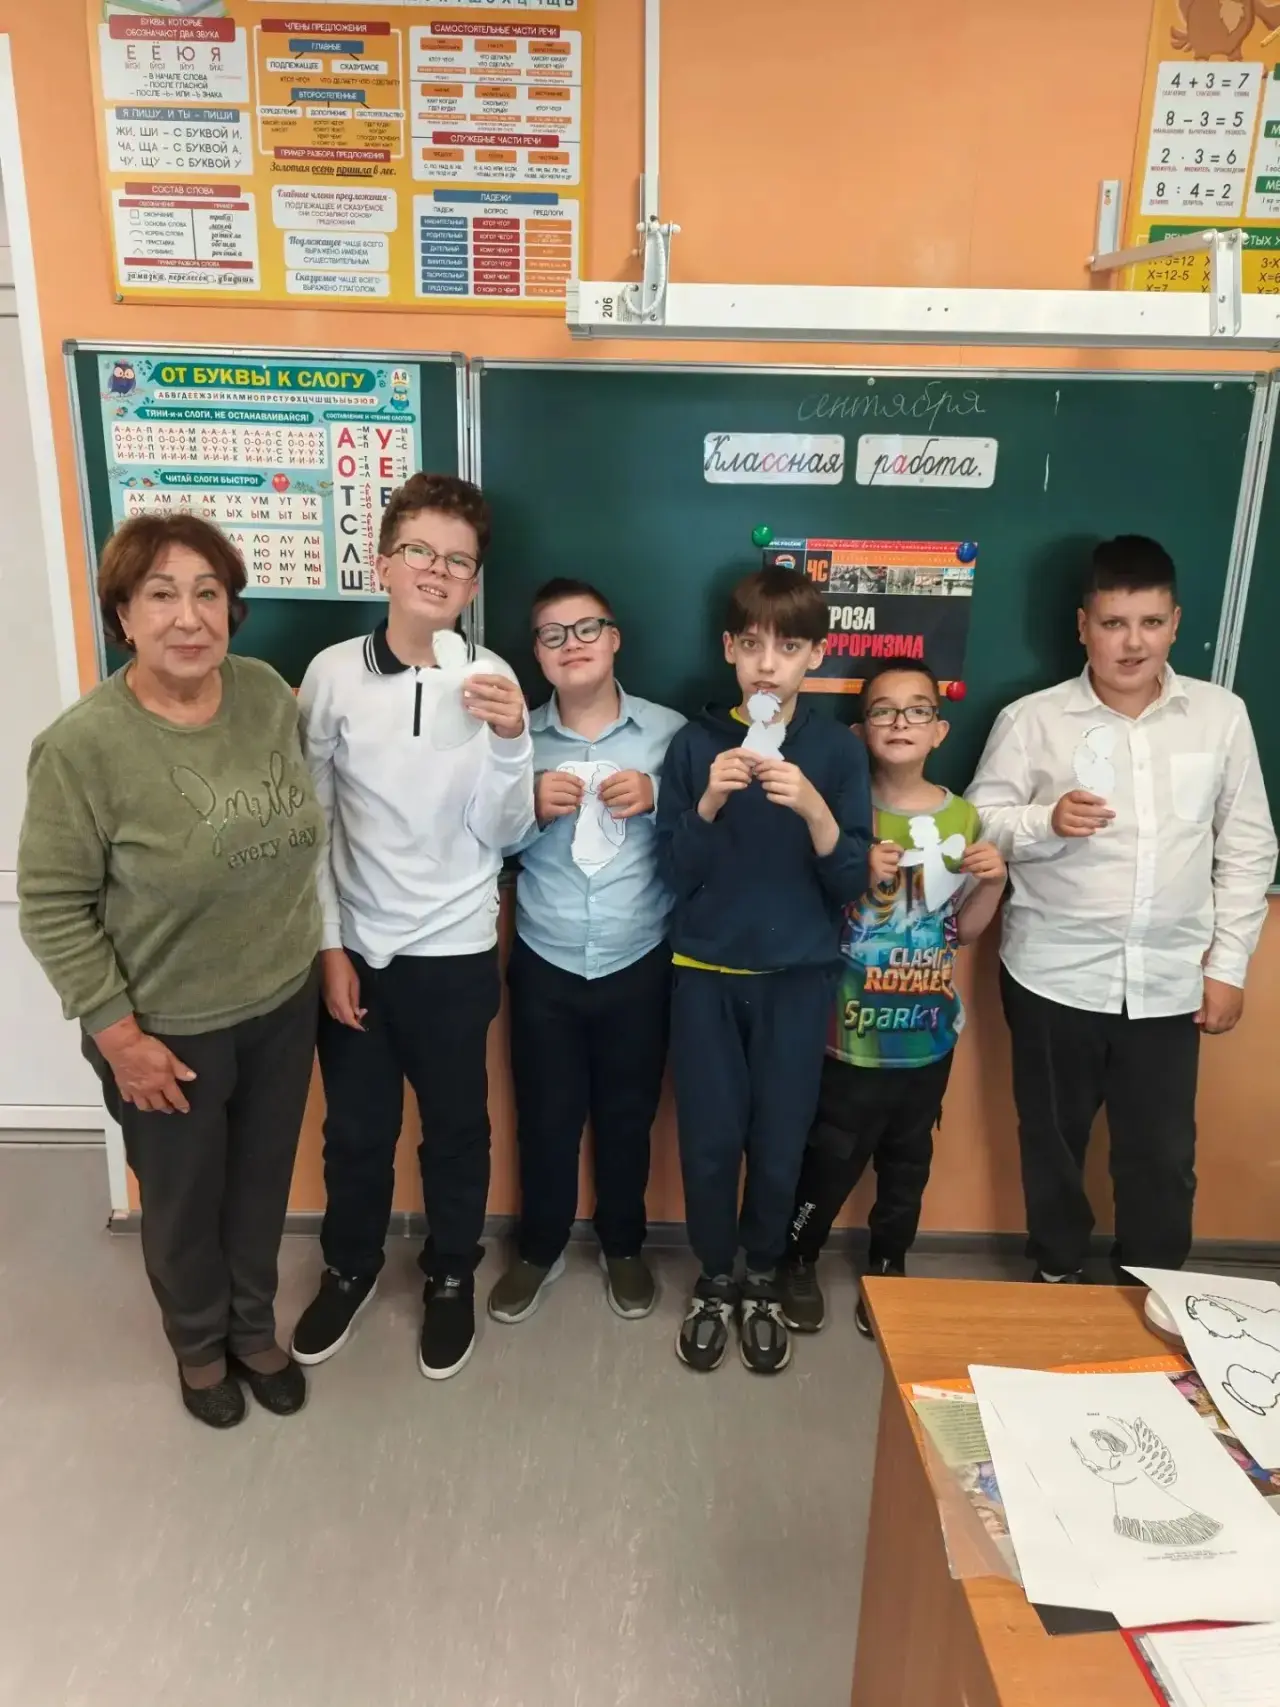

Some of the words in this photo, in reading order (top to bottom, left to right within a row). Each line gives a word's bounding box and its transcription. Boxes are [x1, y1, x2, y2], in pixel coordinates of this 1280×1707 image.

[126, 29, 176, 37] ОБОЗНАЧАЮТ
[180, 30, 195, 38] ДВА
[311, 23, 367, 32] ПРЕДЛОЖЕНИЯ
[435, 25, 510, 34] САМОСТОЯТЕЛЬНЫЕ
[512, 27, 536, 35] ЧАСТИ
[127, 45, 136, 60] Е
[152, 41, 161, 60] Ё
[177, 46, 195, 61] Ю
[211, 47, 221, 62] Я
[270, 61, 319, 70] ПОДЛЕЖАЩЕЕ
[1171, 72, 1181, 88] 4
[1189, 78, 1198, 88] +
[1206, 73, 1215, 88] 3
[1222, 79, 1231, 87] =
[1238, 73, 1249, 88] 7
[299, 91, 357, 99] ВТОРОСТЕПЕННЫЕ
[178, 110, 190, 118] ТЫ
[204, 111, 232, 119] ПИШИ
[1166, 111, 1174, 126] 8
[1200, 111, 1209, 126] 3
[1216, 117, 1226, 125] =
[1233, 112, 1243, 127] 5
[116, 126, 135, 137] ЖИ,
[140, 127, 158, 136] ШИ
[174, 128, 182, 136] С
[186, 127, 228, 138] БУКВОЙ
[232, 129, 242, 139] И,
[450, 136, 495, 144] СЛУЖЕБНЫЕ
[497, 137, 522, 145] ЧАСТИ
[118, 142, 135, 152] ЧА,
[139, 143, 158, 153] ЩА
[174, 143, 181, 152] С
[186, 141, 227, 153] БУКВОЙ
[232, 145, 241, 154] А,
[120, 157, 136, 166] ЧУ,
[142, 157, 160, 167] ЩУ
[176, 158, 184, 167] С
[189, 156, 230, 168] БУКВОЙ
[235, 160, 241, 168] У
[1161, 148, 1170, 163] 2
[1195, 149, 1204, 163] 3
[1227, 150, 1236, 164] 6
[270, 162, 310, 173] Золотая
[312, 164, 334, 173] осень
[336, 165, 372, 175] пришла
[373, 163, 378, 174] в
[379, 167, 396, 175] лес.
[186, 186, 214, 194] СЛОВА
[1156, 182, 1165, 197] 8
[1190, 183, 1200, 198] 4
[1206, 189, 1215, 197] =
[1222, 184, 1231, 199] 2
[481, 194, 512, 202] ПАДЕЖИ
[603, 297, 613, 318] 206
[162, 367, 187, 383] ОТ
[194, 368, 270, 386] БУКВЫ
[279, 371, 292, 386] К
[298, 371, 365, 388] СЛОГУ
[798, 381, 986, 430] сентября
[185, 410, 213, 419] СЛОГИ,
[229, 411, 309, 422] ОСТАНАВЛИВАЙСЯ!
[338, 428, 355, 448] А
[376, 429, 392, 450] У
[338, 455, 355, 477] О
[380, 457, 393, 478] Е
[704, 436, 843, 473] Классная
[869, 439, 982, 486] работа.
[166, 473, 191, 484] ЧИТАЙ
[194, 475, 219, 484] СЛОГИ
[221, 476, 257, 485] БЫСТРО!
[129, 494, 144, 502] АХ
[154, 495, 171, 503] АМ
[227, 496, 241, 504] УХ
[252, 497, 268, 505] УМ
[280, 498, 291, 506] УТ
[302, 498, 316, 506] УК
[341, 486, 355, 506] Т
[203, 508, 216, 517] ОК
[227, 509, 242, 517] ЫХ
[251, 511, 269, 519] ЫМ
[279, 511, 292, 520] ЫТ
[302, 512, 317, 520] ЫК
[340, 514, 358, 535] С
[229, 534, 244, 543] ЛА
[254, 535, 269, 544] ЛО
[280, 536, 293, 544] ЛУ
[304, 537, 319, 545] ЛЫ
[254, 549, 270, 558] НО
[280, 550, 294, 558] НУ
[305, 551, 320, 559] НЫ
[343, 544, 360, 563] Л
[254, 562, 272, 571] МО
[280, 563, 296, 572] МУ
[305, 564, 321, 573] МЫ
[807, 560, 828, 581] ЧС
[257, 576, 270, 584] ТО
[280, 577, 293, 585] ТУ
[307, 577, 320, 585] ТЫ
[342, 571, 363, 590] Ш
[170, 750, 304, 857] Smile
[228, 838, 281, 868] every
[289, 826, 316, 848] day
[864, 967, 943, 993] ROYALE
